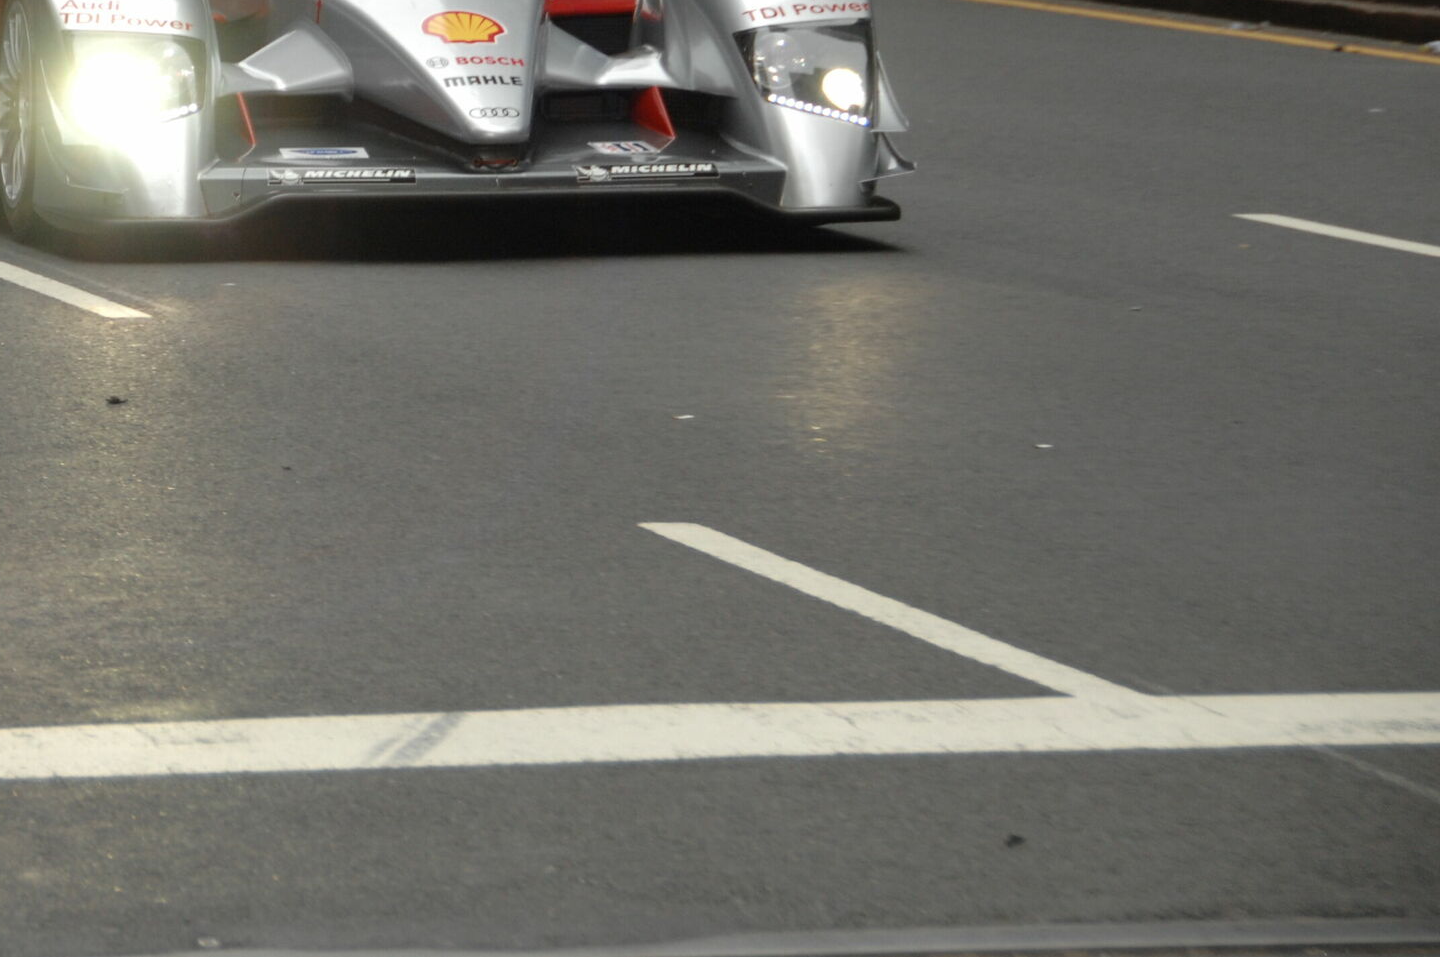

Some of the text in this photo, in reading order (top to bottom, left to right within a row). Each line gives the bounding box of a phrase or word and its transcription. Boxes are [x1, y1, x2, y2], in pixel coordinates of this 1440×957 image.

[61, 0, 120, 10] Audi
[742, 2, 871, 21] TDI Power
[59, 12, 193, 31] TDI Power
[456, 56, 525, 66] BOSCH
[444, 75, 523, 87] MAHLE
[304, 170, 411, 178] MICHELIN
[611, 163, 713, 174] MICHELIN
